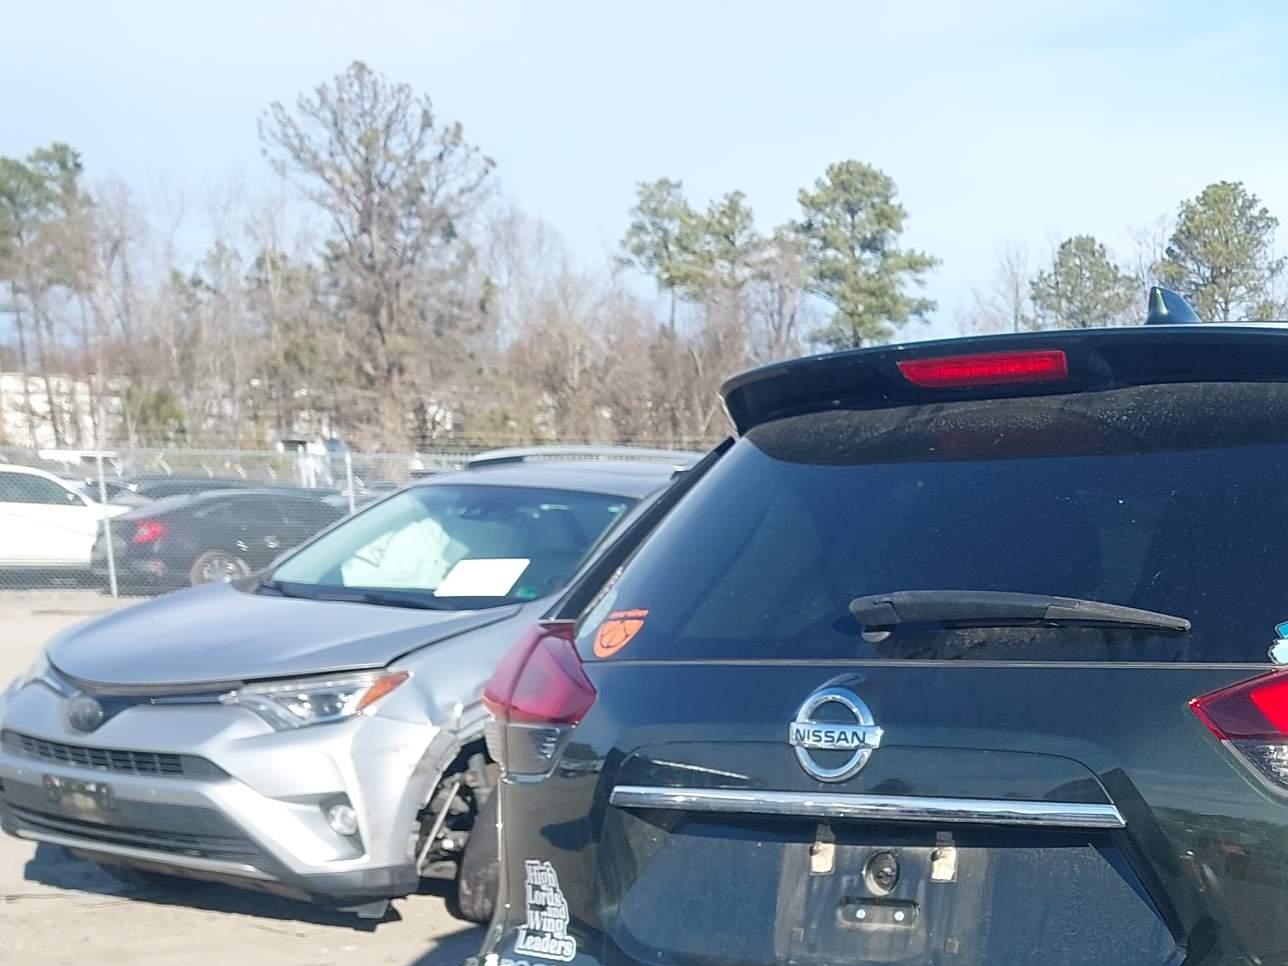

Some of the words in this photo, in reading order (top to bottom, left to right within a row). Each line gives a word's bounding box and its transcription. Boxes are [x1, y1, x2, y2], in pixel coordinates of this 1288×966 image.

[794, 727, 867, 744] NISSAN
[526, 863, 558, 890] High
[527, 884, 565, 907] Lords
[527, 910, 566, 938] Wing
[517, 928, 573, 957] Leaders
